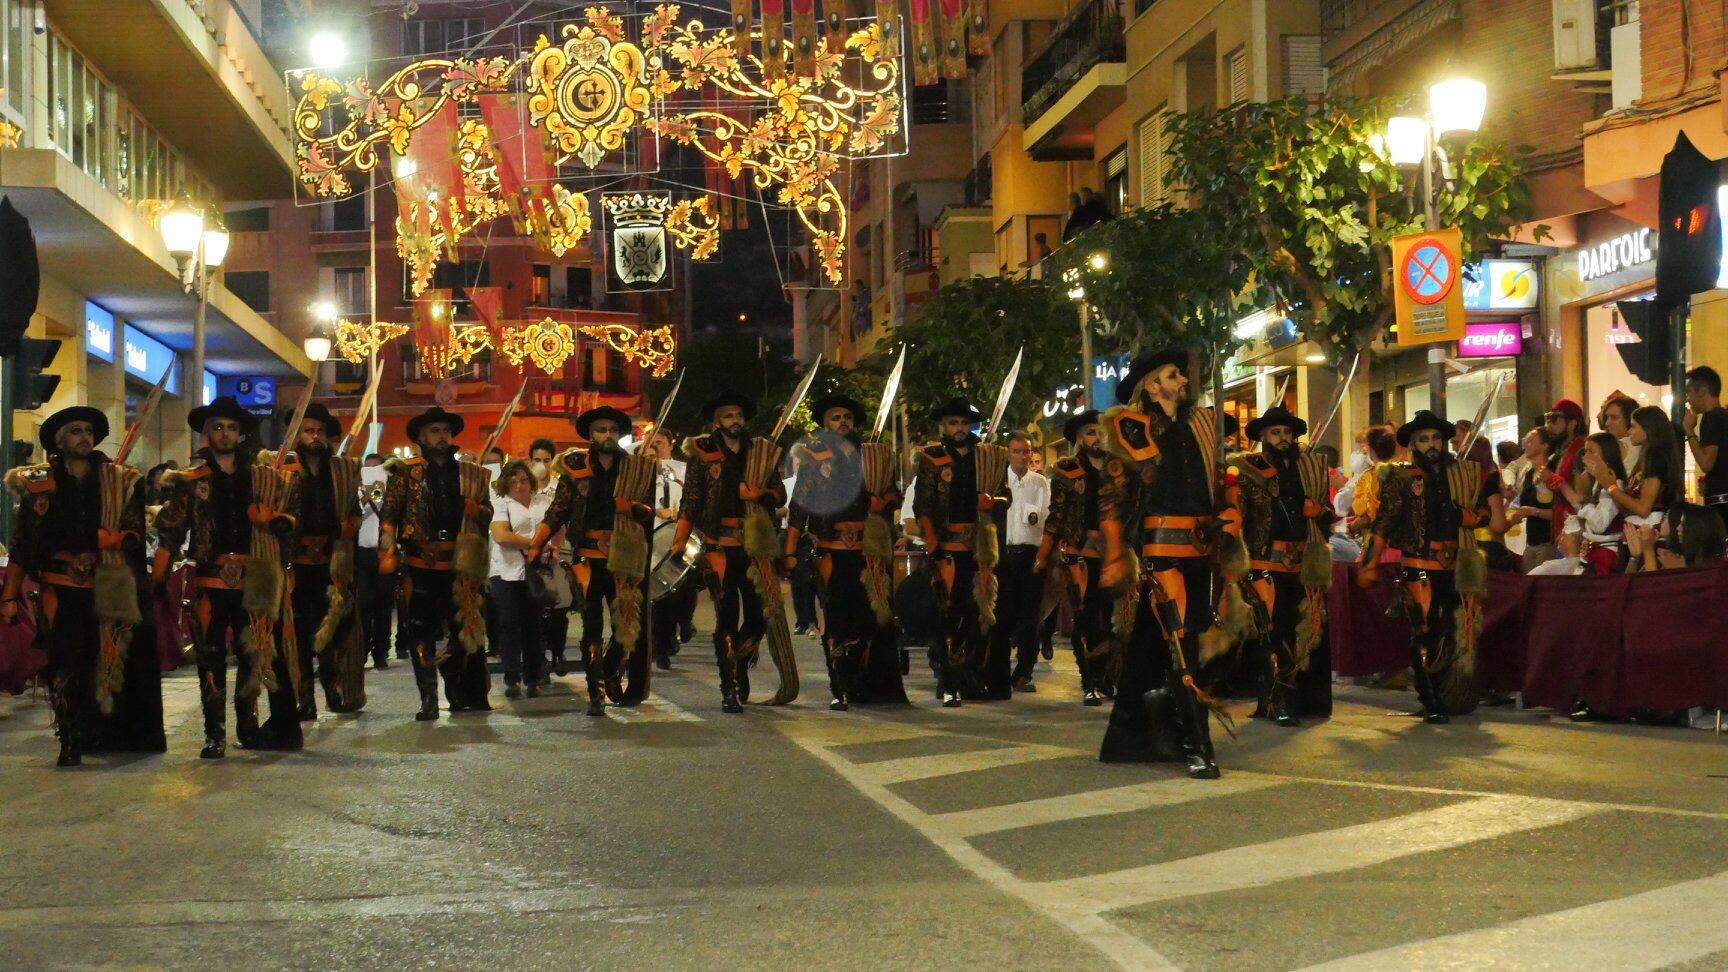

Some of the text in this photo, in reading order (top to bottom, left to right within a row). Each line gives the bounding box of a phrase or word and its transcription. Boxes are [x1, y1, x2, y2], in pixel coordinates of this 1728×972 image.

[1578, 227, 1651, 282] PARFOIS
[1463, 323, 1516, 350] renfe
[240, 381, 272, 404] B S
